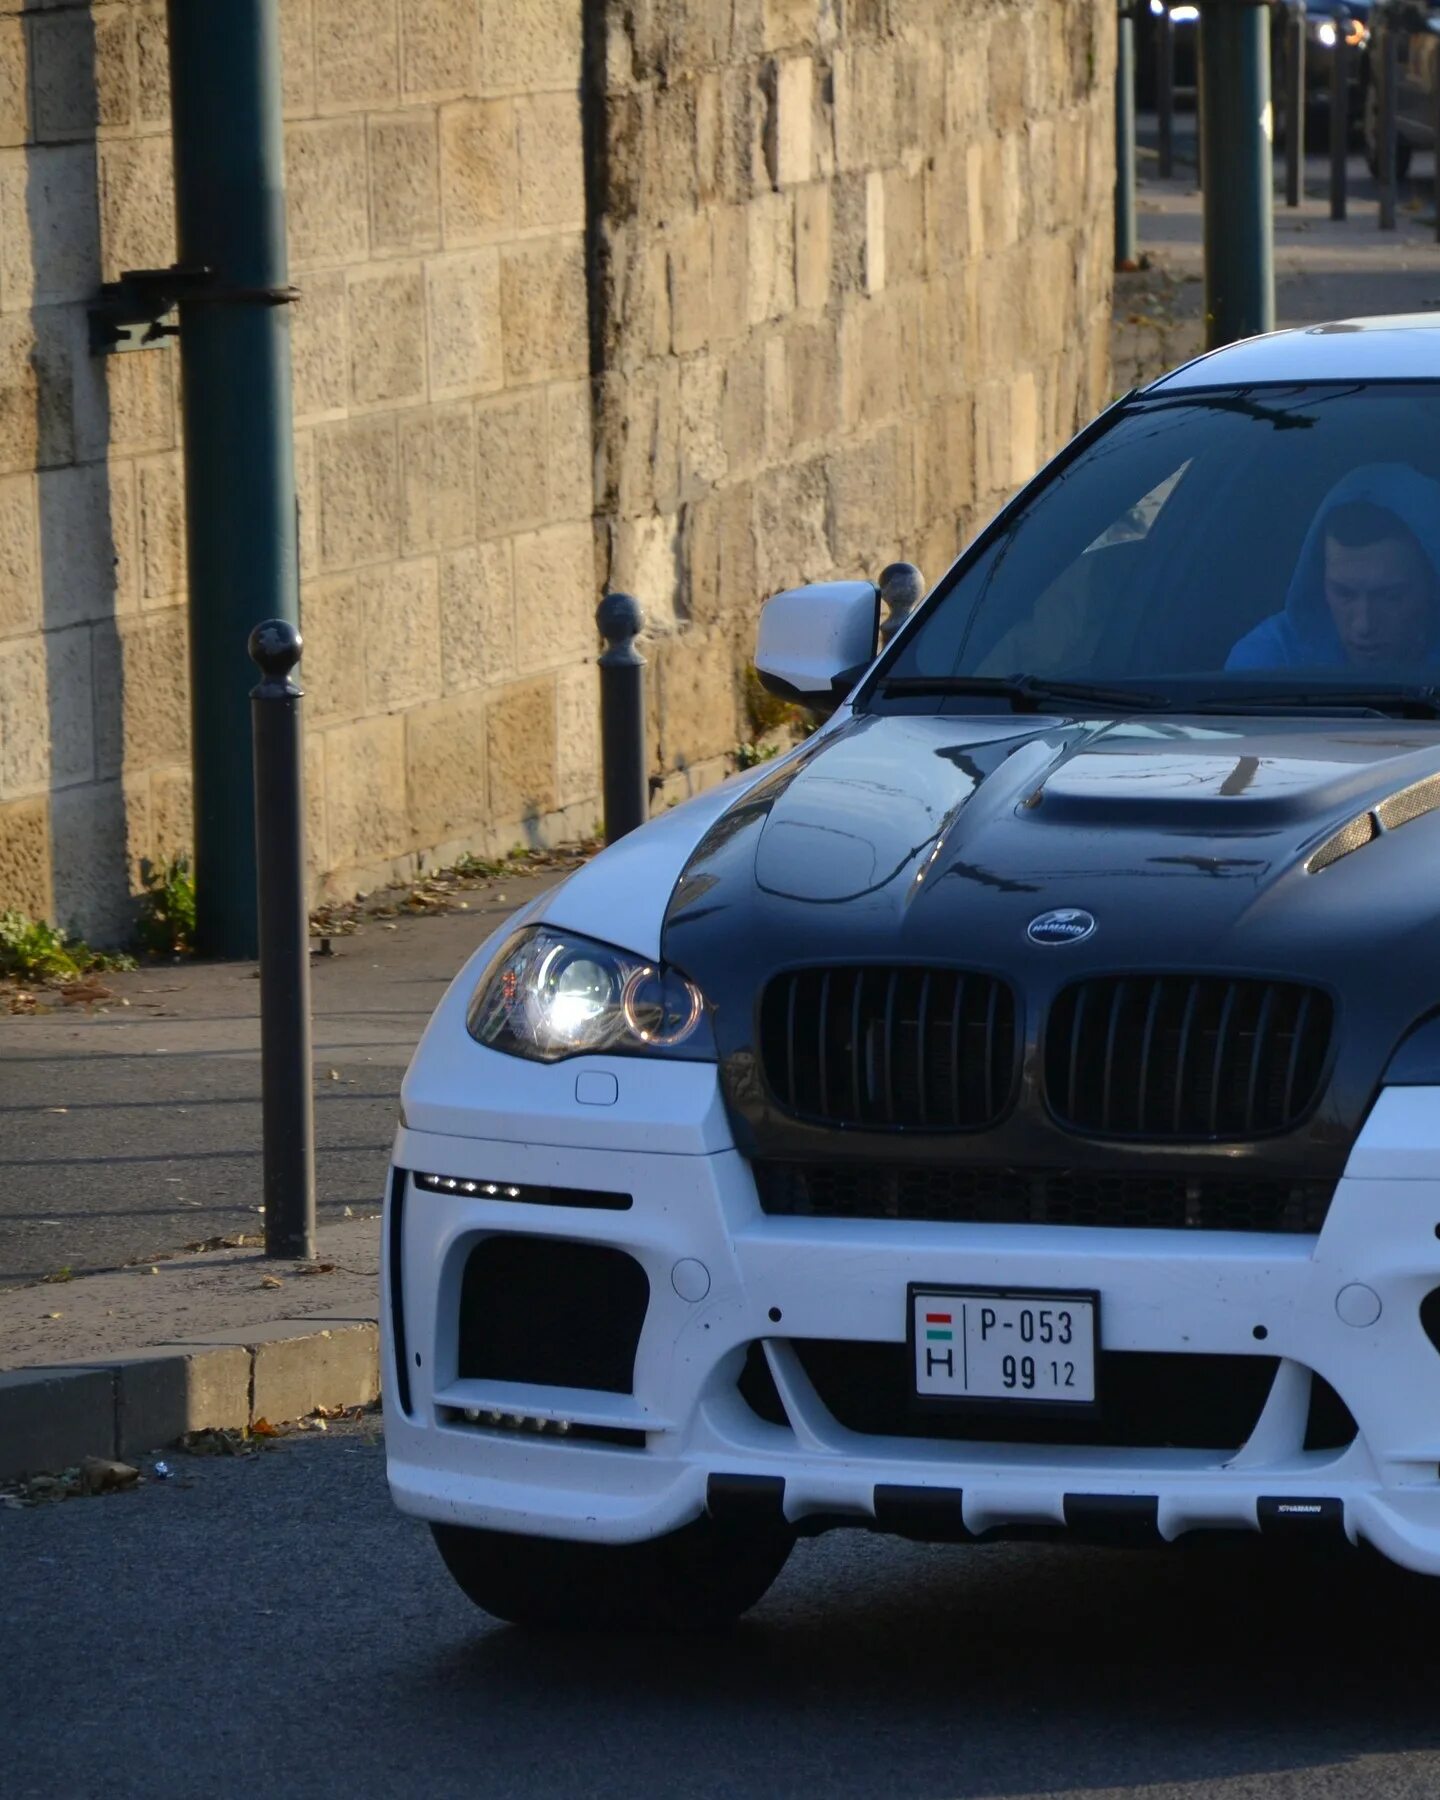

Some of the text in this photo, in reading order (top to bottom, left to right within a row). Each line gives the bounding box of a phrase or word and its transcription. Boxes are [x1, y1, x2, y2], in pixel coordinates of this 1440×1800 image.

[981, 1308, 1073, 1344] P-053
[926, 1348, 953, 1378] H
[1002, 1354, 1075, 1389] 99 12
